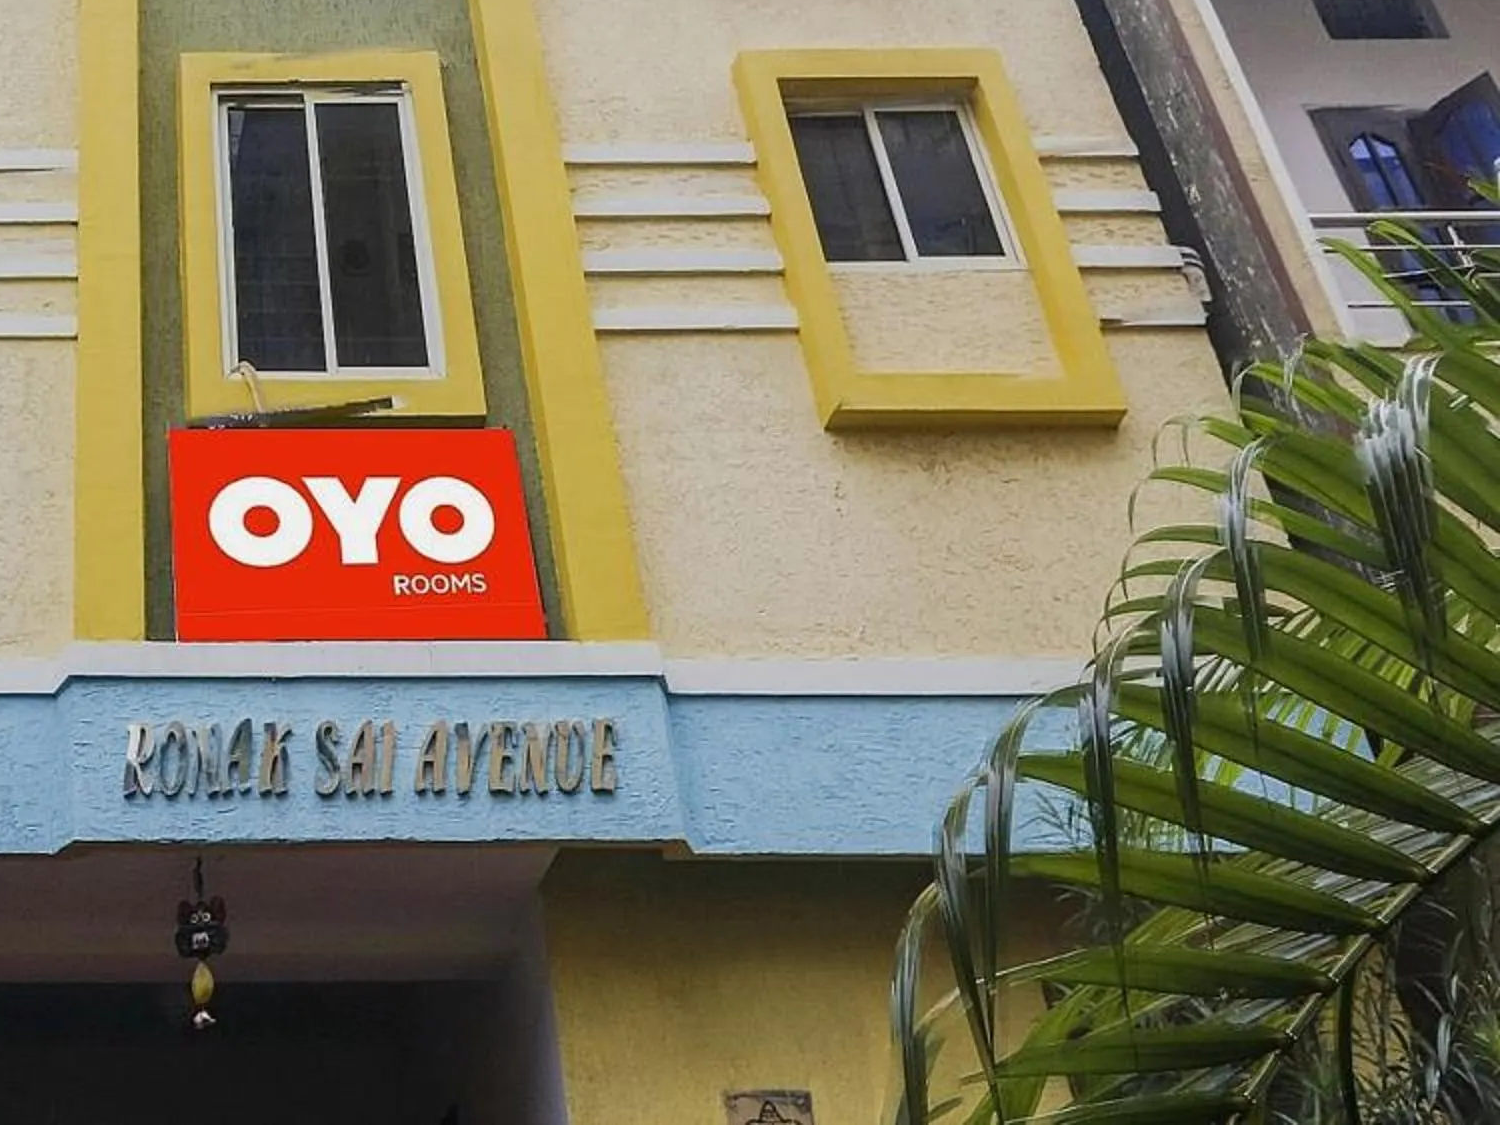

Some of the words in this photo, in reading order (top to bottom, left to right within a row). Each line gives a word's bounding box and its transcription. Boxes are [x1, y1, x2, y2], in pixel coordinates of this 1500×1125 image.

[208, 476, 495, 567] OYO
[393, 573, 487, 595] ROOMS
[314, 719, 396, 798] SAI
[413, 718, 619, 797] AVENUE
